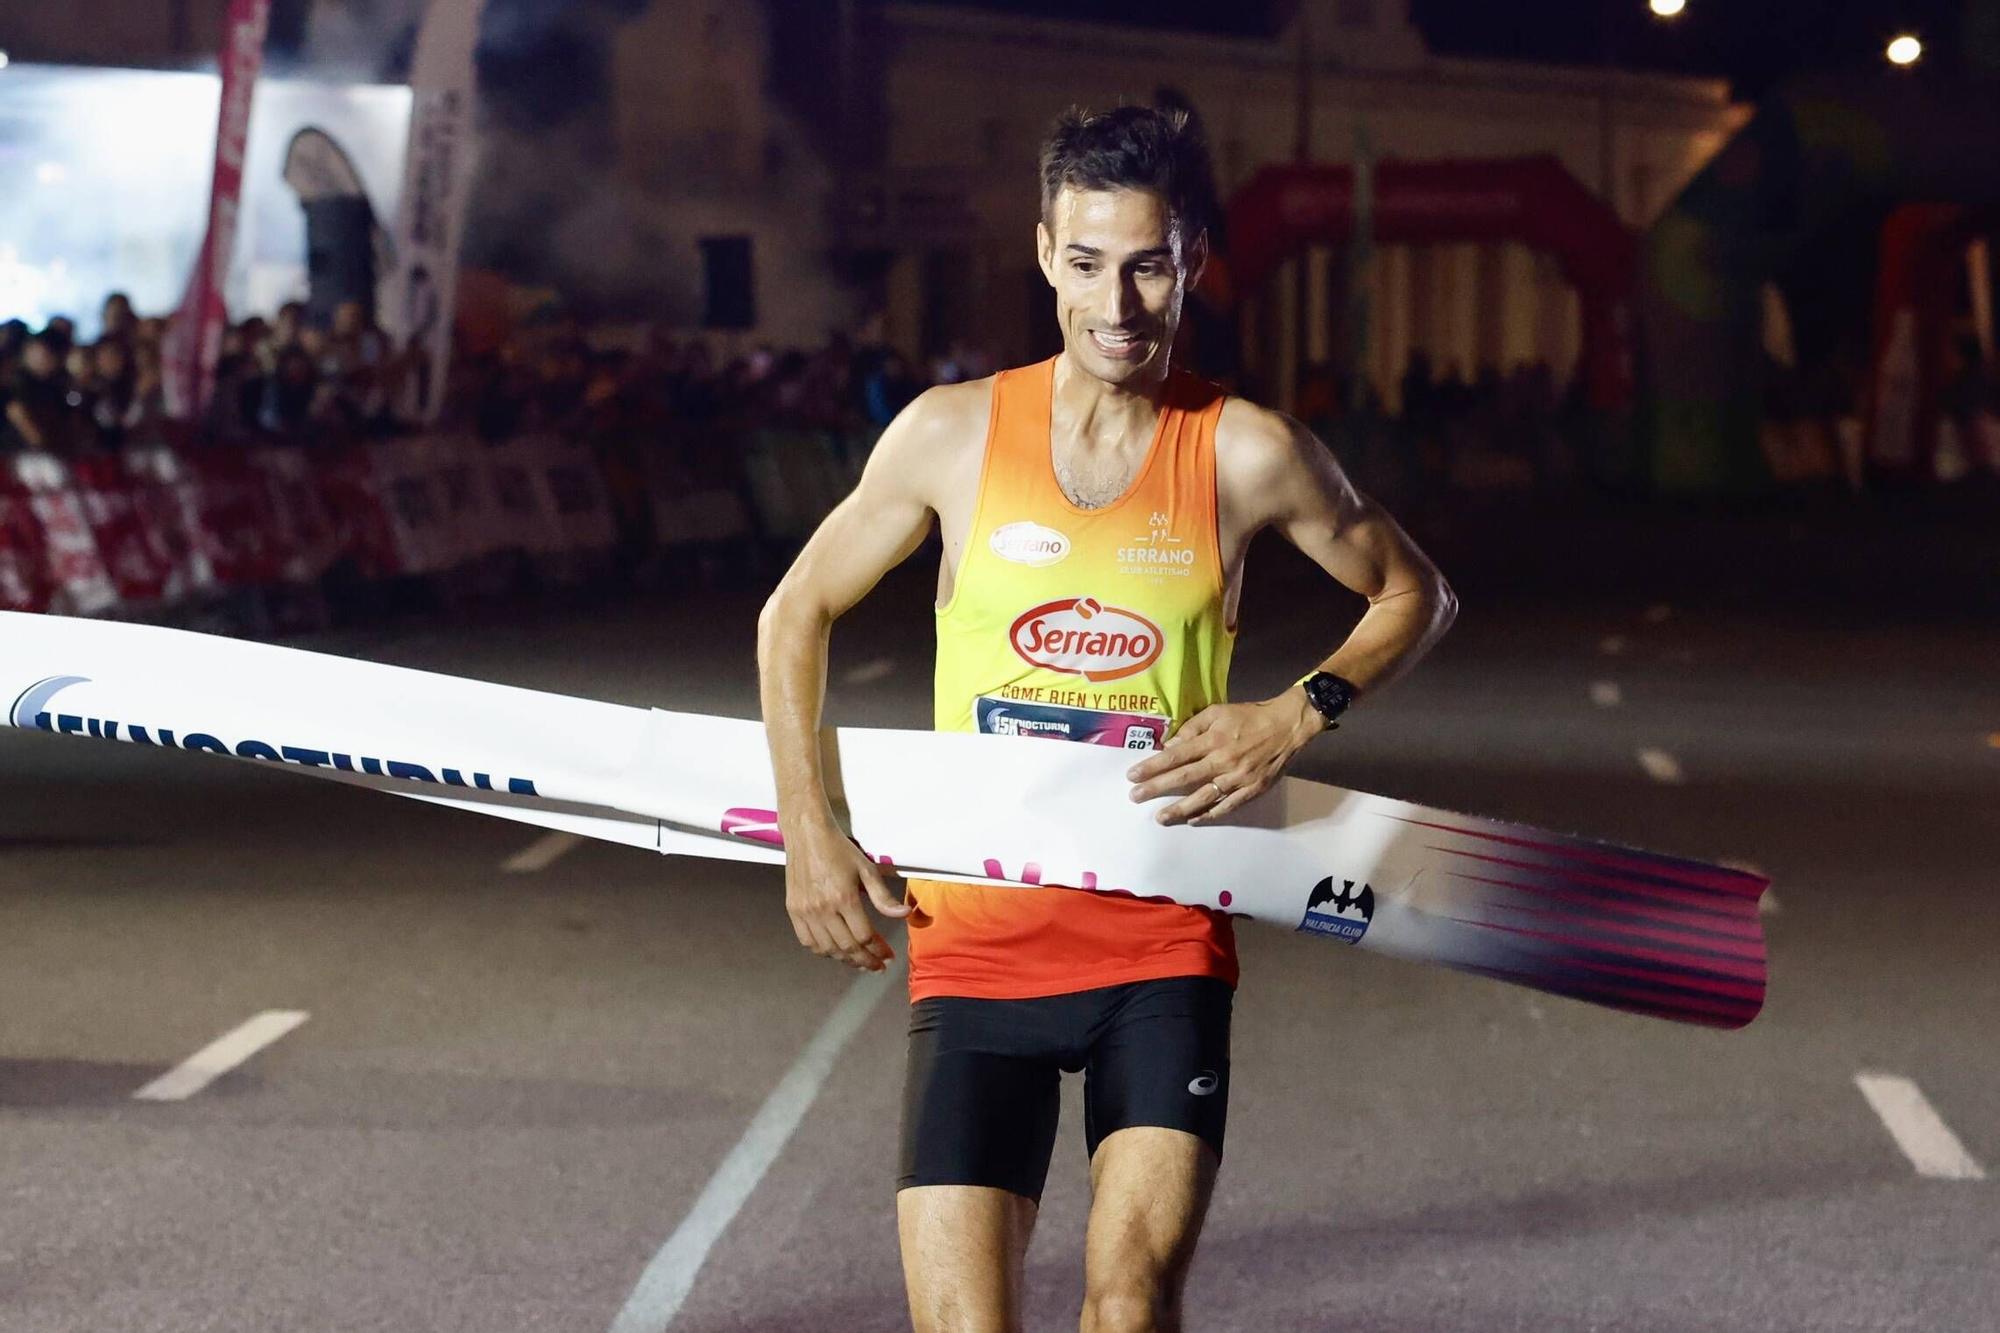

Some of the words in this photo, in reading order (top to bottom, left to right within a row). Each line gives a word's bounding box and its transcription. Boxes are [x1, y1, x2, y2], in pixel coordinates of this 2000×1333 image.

[1117, 547, 1194, 565] SERRANO
[1024, 619, 1151, 659] Serrano
[1001, 684, 1044, 702] COME
[1050, 690, 1086, 708] BIEN
[1094, 693, 1103, 709] Y
[1109, 694, 1159, 711] CORRE
[1019, 719, 1071, 734] NOCTURNA
[1129, 729, 1154, 739] SUB
[1305, 919, 1341, 934] VALENCIA
[1342, 926, 1362, 936] CLUB
